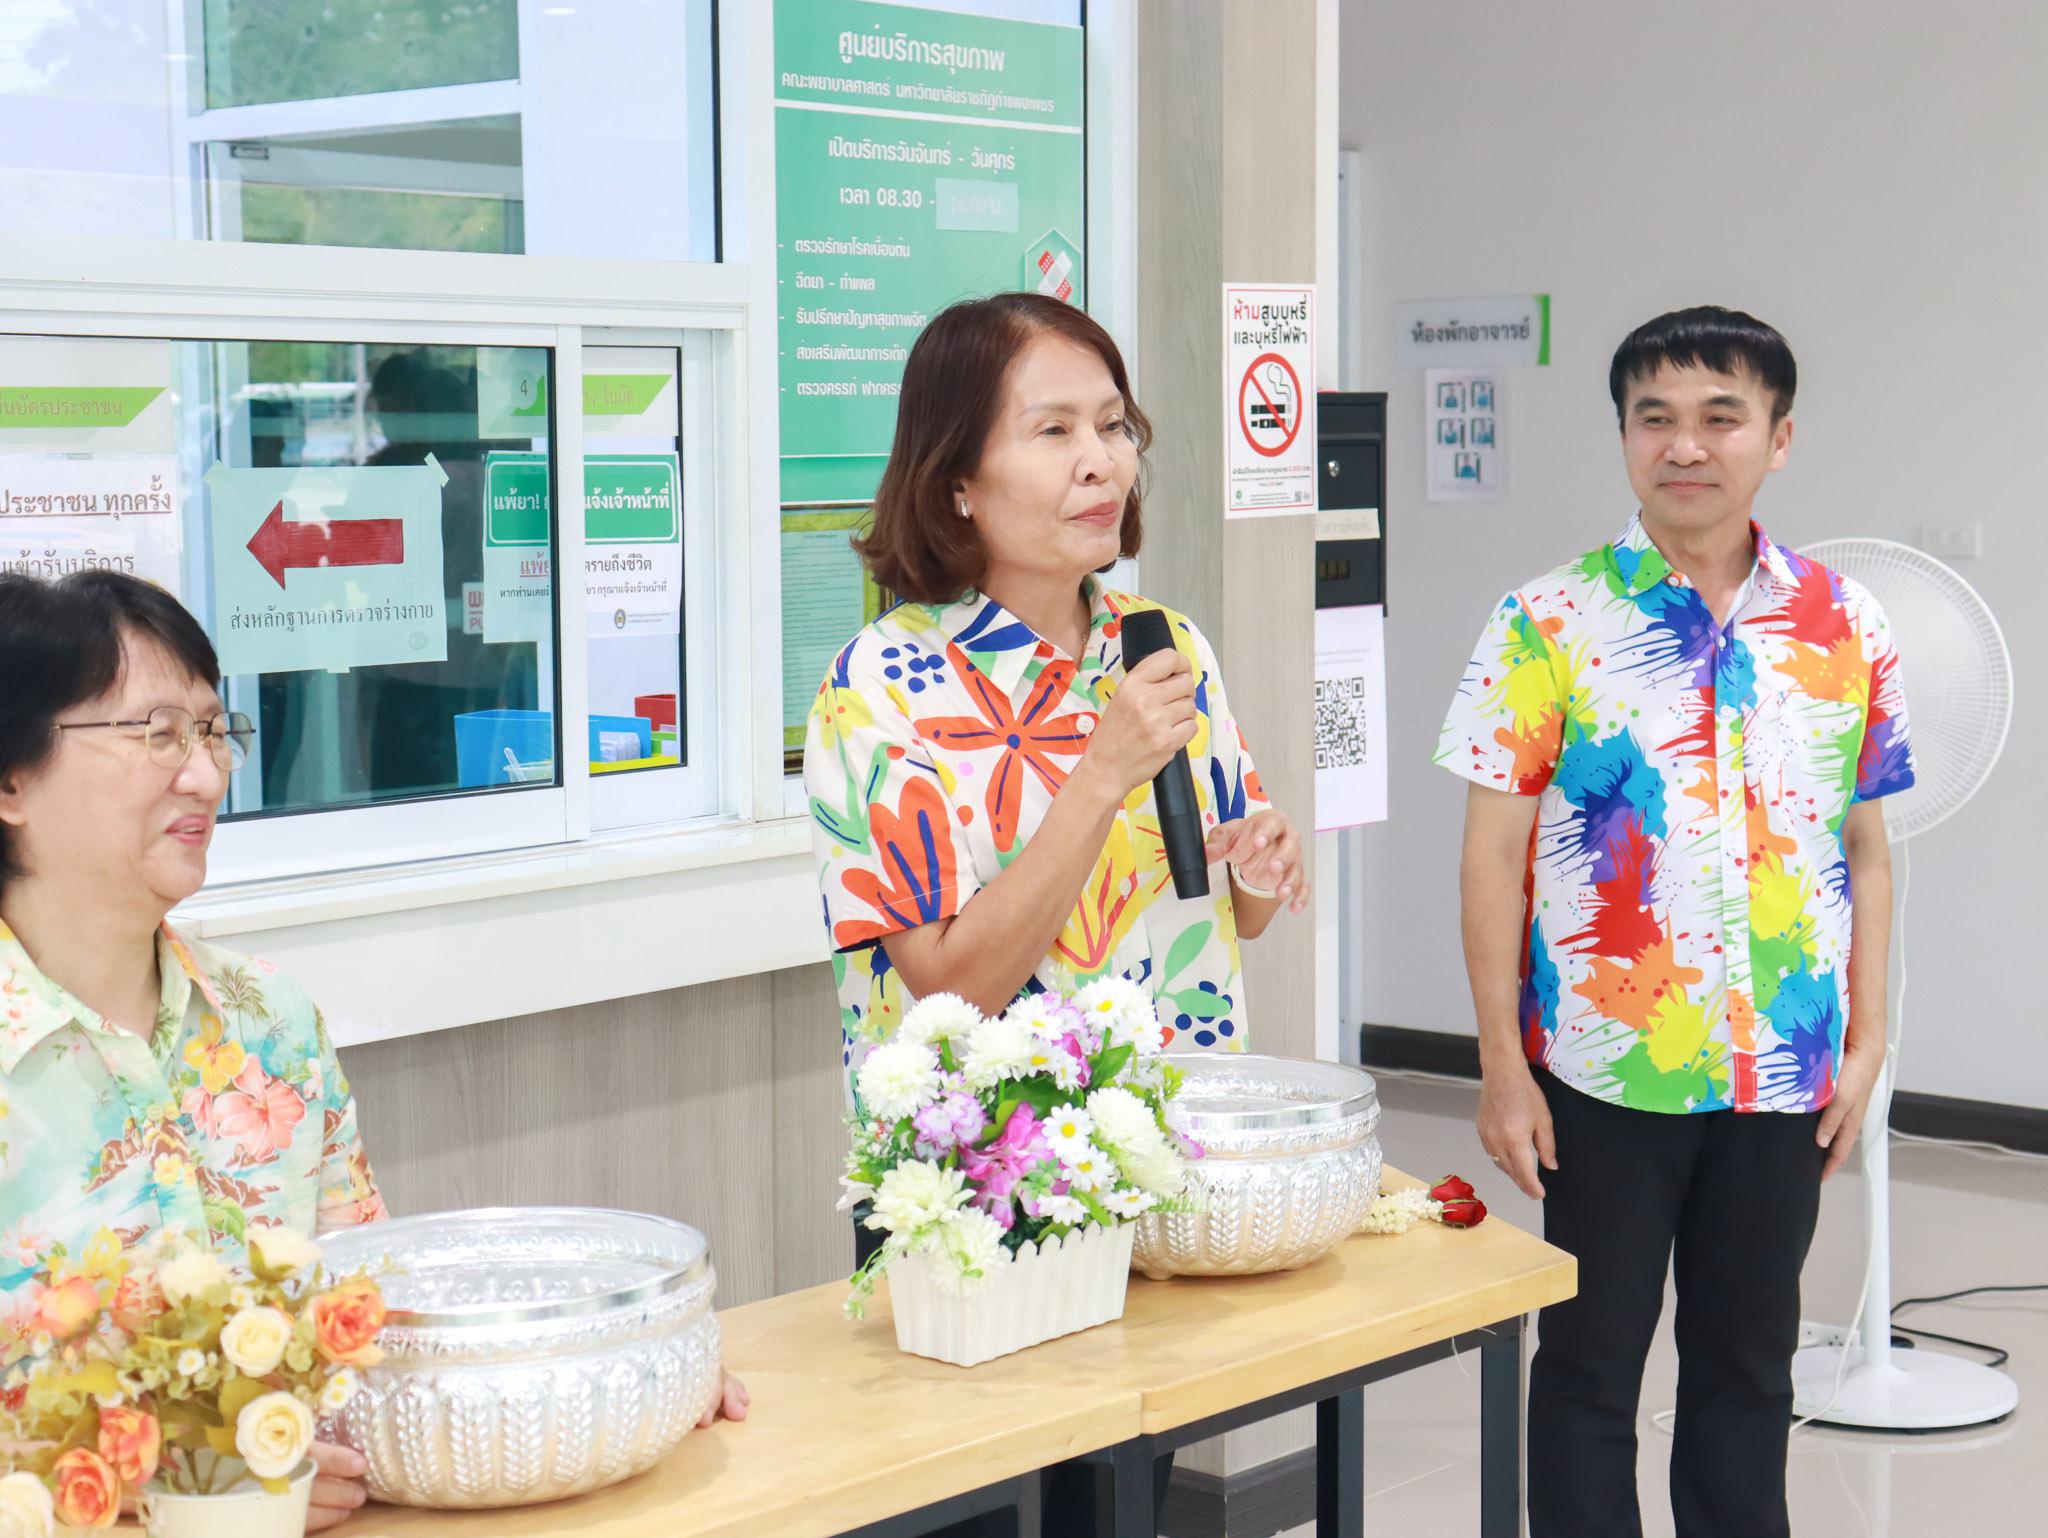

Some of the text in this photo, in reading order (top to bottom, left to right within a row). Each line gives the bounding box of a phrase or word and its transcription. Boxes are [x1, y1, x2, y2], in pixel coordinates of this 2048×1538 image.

[839, 23, 1005, 74] ศูนย์บริการสุขภาพ
[782, 71, 891, 97] คณะพยาบาลศาสตร์
[828, 136, 952, 166] เปิดบริการวันจันทร์
[971, 146, 1016, 174] วันศุกร์
[840, 187, 870, 206] เวลา
[876, 187, 923, 208] 08.30
[795, 235, 911, 258] ตรวจรักษาโรคเบื้องต้น
[795, 271, 824, 289] ฉีดยา
[840, 273, 876, 291] ทำแผล
[1234, 294, 1308, 327] ห้ามสูบบุหรี่
[1234, 323, 1308, 349] และบุหรี่ไฟฟ้า
[1412, 316, 1531, 345] ห้องพักอาจารย์
[520, 379, 529, 396] 4
[797, 376, 857, 397] ตรวจครรภ์
[0, 393, 122, 416] นบัตรประชาชน
[104, 474, 171, 521] ทุกครั้ง
[493, 486, 541, 511] แพ้ยา!
[231, 599, 434, 632] ส่งหลักฐานการตรวจร่างกาย
